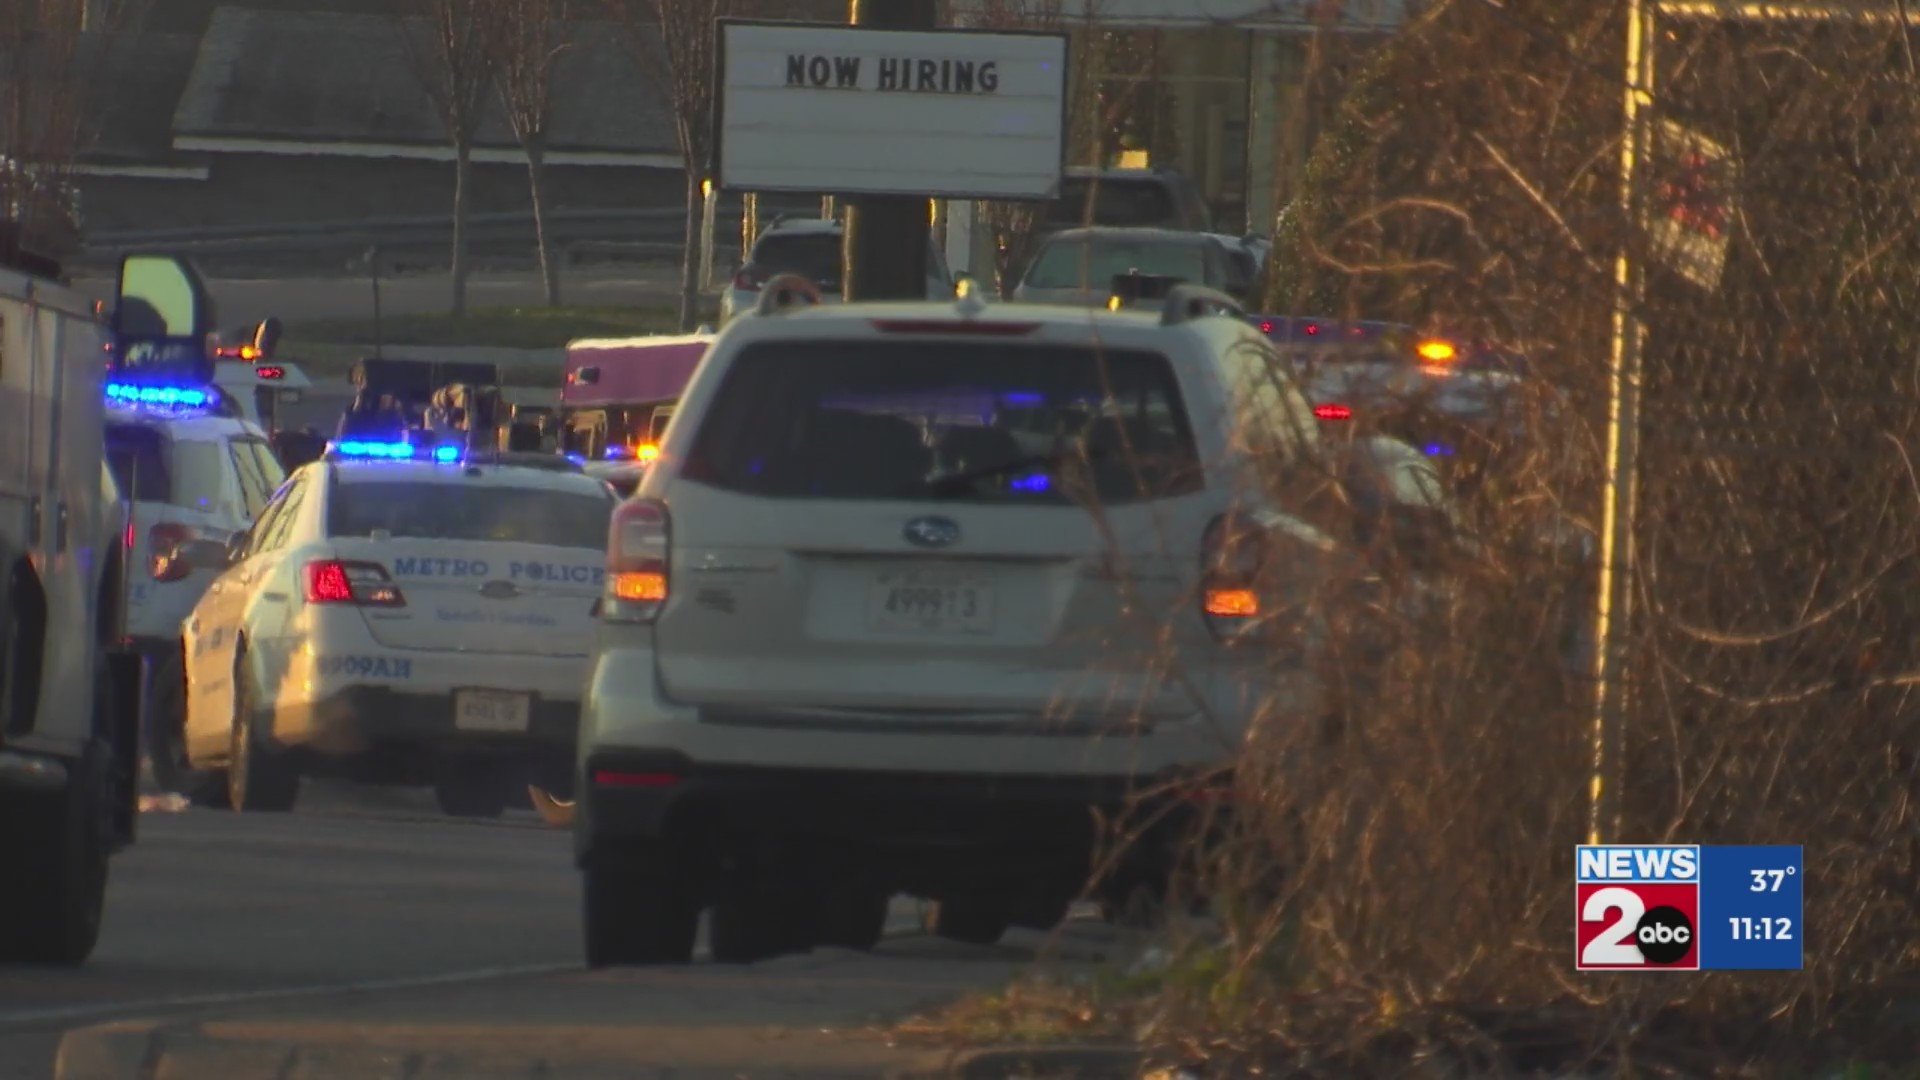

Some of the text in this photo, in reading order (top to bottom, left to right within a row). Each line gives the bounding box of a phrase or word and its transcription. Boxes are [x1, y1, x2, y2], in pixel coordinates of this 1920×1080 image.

[787, 54, 998, 92] NOW HIRING
[394, 557, 606, 584] METRO POLICE
